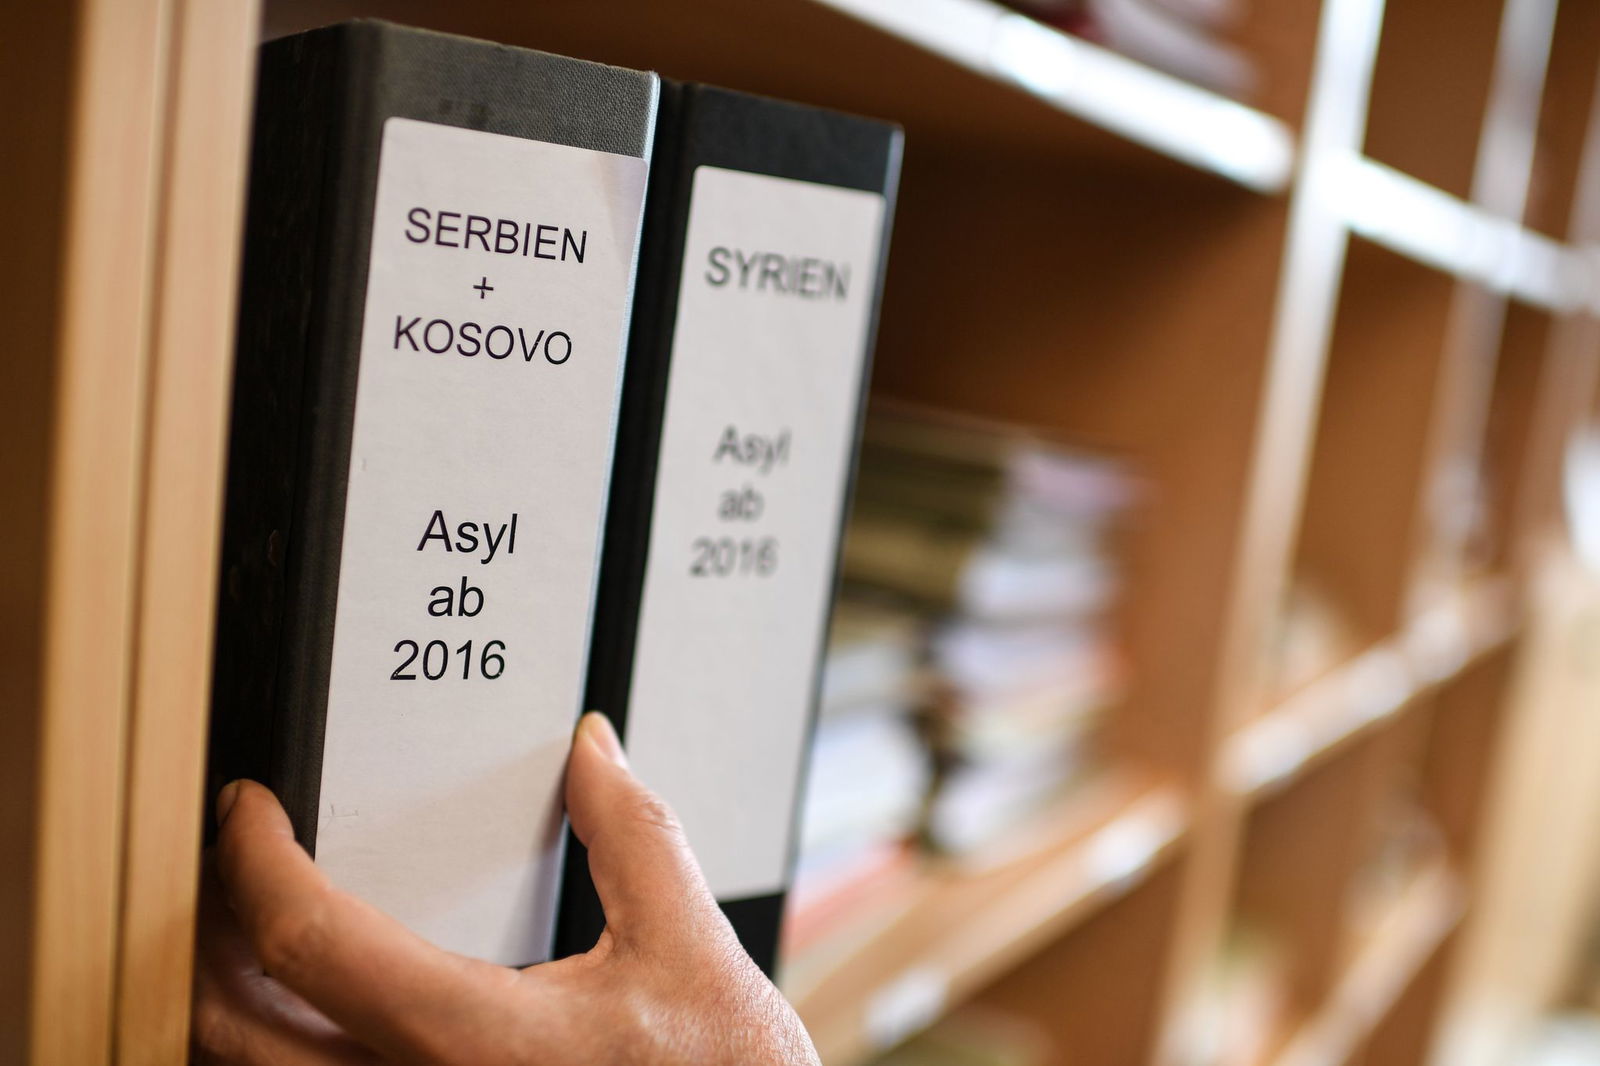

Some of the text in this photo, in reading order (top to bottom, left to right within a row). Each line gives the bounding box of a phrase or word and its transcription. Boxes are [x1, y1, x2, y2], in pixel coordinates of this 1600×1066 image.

[404, 207, 588, 264] SERBIEN
[705, 246, 849, 301] SYRIEN
[393, 315, 573, 366] KOSOVO
[714, 426, 791, 473] Asyl
[719, 487, 763, 521] ab
[417, 509, 518, 565] Asyl
[690, 538, 778, 577] 2016
[427, 576, 485, 618] ab
[389, 639, 507, 682] 2016
